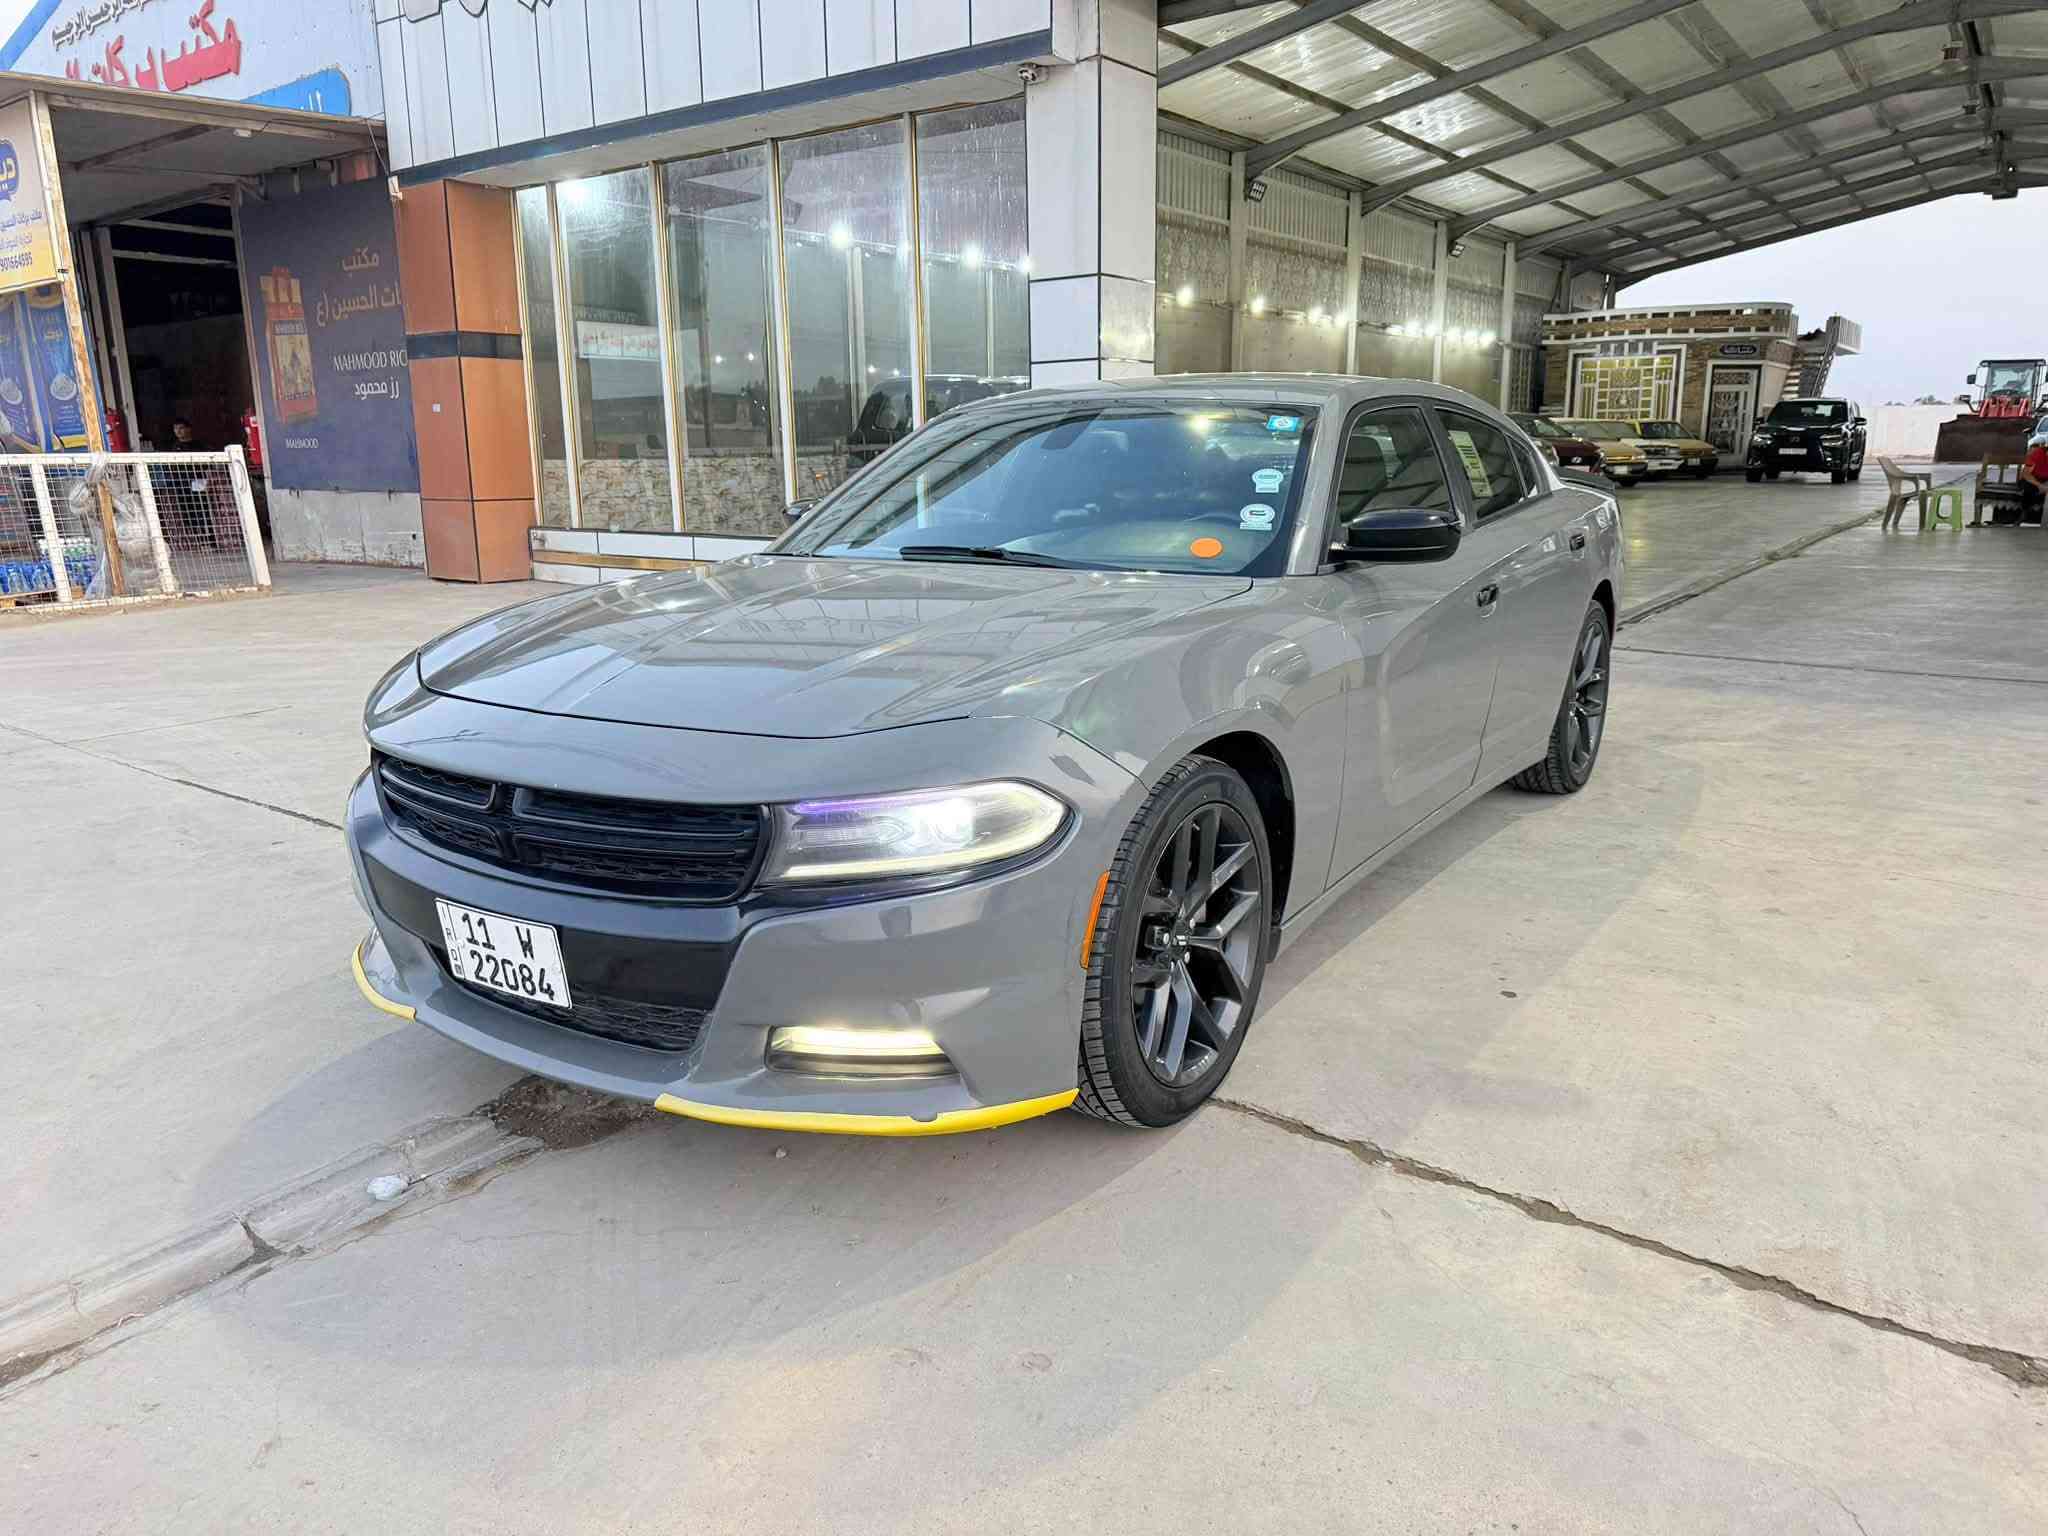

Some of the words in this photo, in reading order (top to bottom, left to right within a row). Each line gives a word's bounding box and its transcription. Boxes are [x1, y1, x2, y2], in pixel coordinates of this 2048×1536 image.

[342, 247, 379, 277] مكتب
[332, 283, 378, 321] الحسين
[334, 351, 387, 371] MAHMOOD
[390, 348, 408, 368] RIC
[354, 381, 388, 401] محمود
[462, 912, 496, 951] 11
[515, 925, 535, 960] W
[469, 949, 555, 1001] 22084
